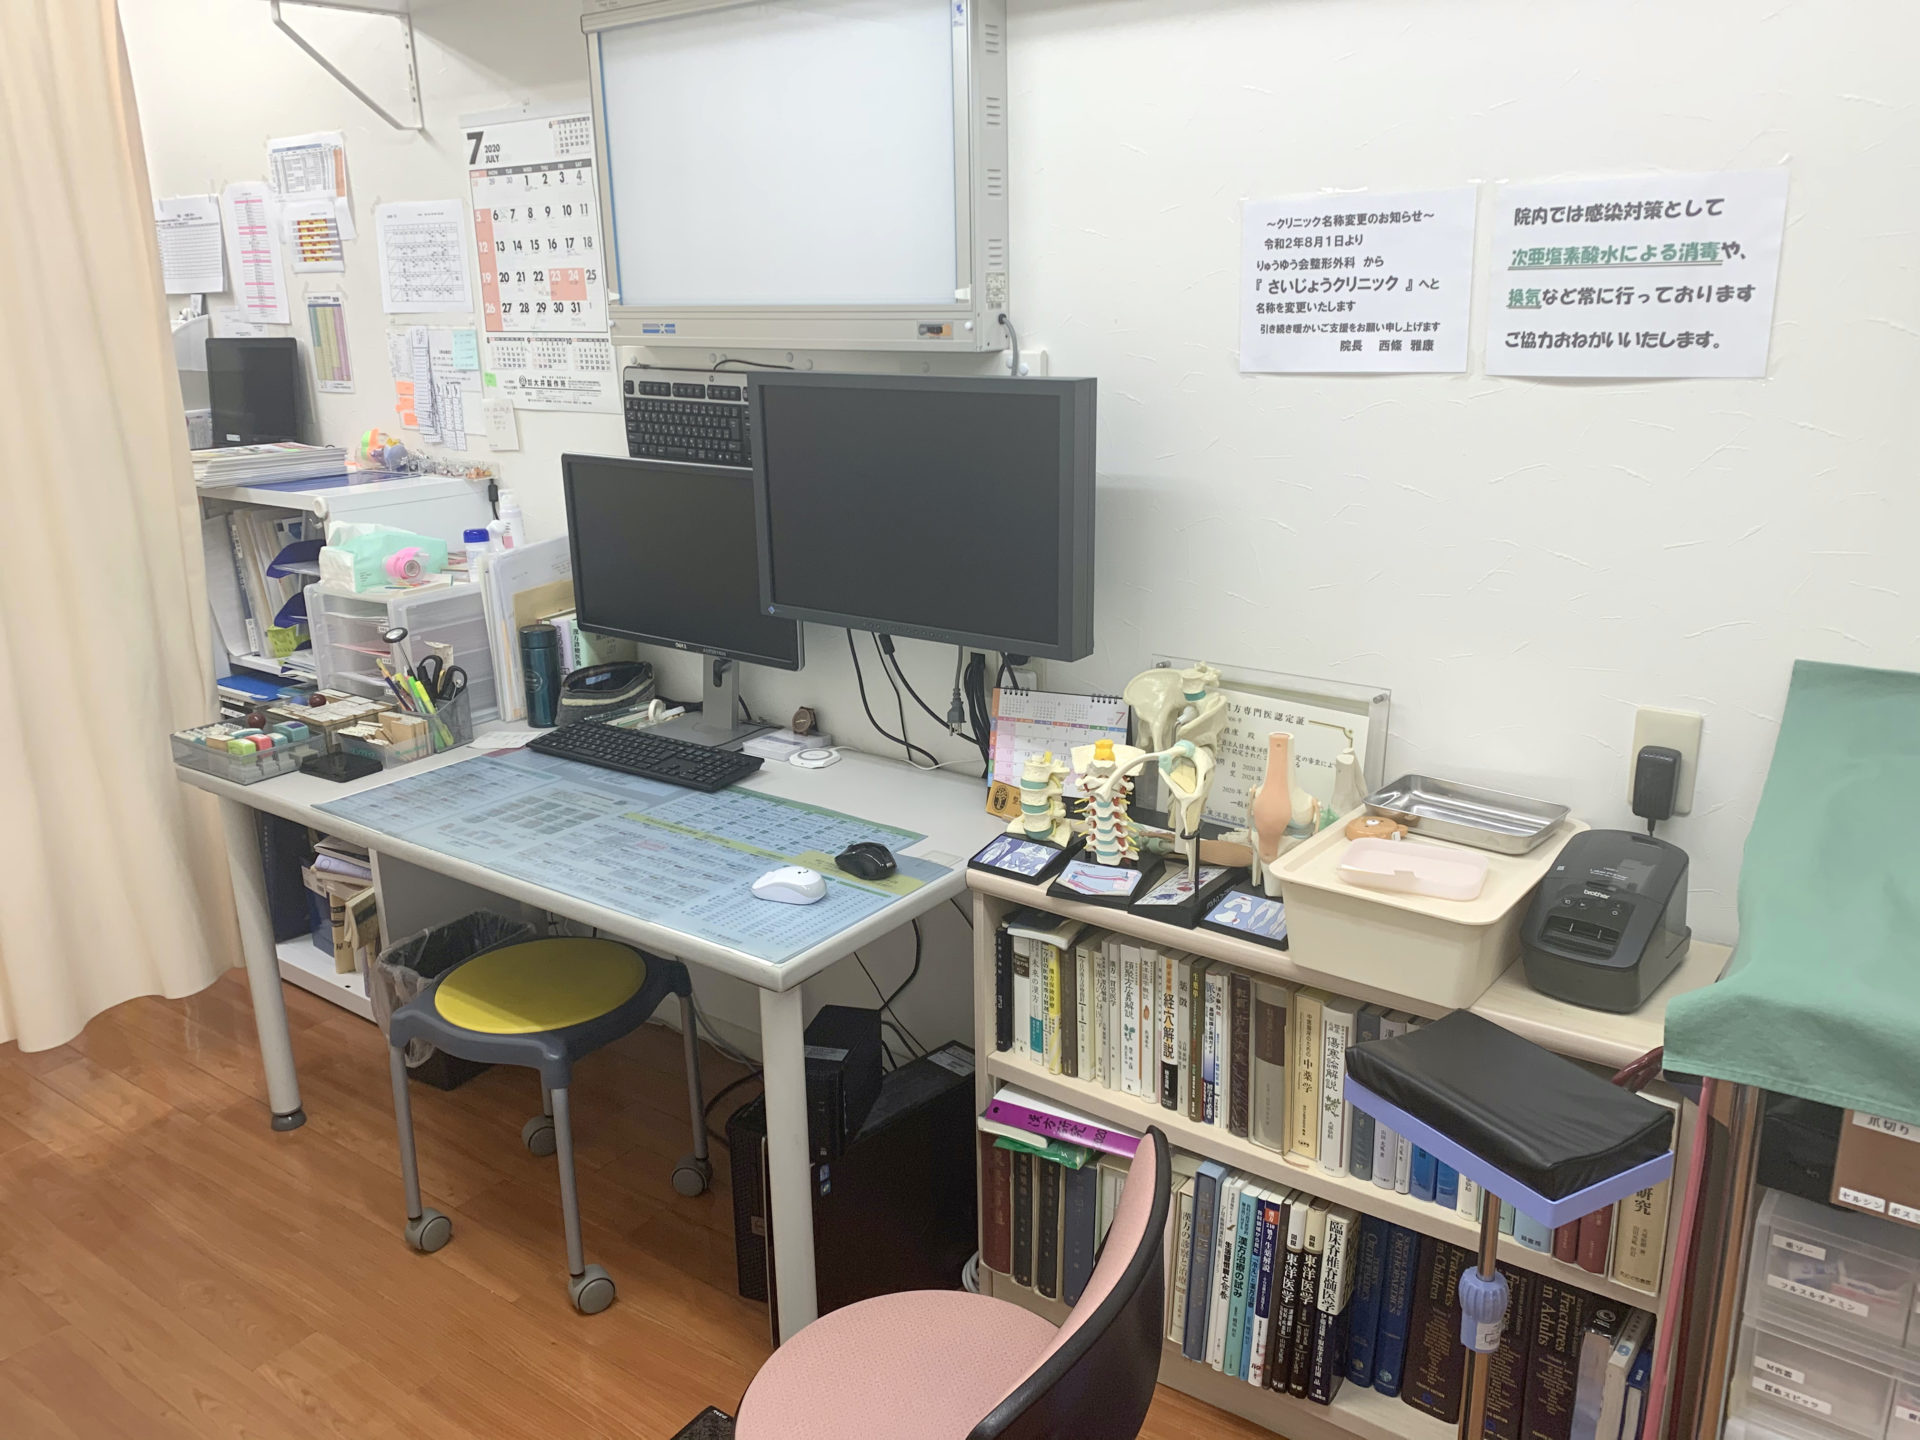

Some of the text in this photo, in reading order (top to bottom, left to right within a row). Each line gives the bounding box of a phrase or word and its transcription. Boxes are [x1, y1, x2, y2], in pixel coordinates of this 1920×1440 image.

[467, 131, 484, 165] 7
[484, 144, 500, 153] 2020
[485, 155, 500, 163] JULY
[525, 175, 529, 185] 1
[542, 174, 548, 184] 2
[560, 172, 565, 183] 3
[576, 170, 582, 181] 4
[476, 204, 588, 222] 5 6 7 8 9 10 11
[1513, 198, 1725, 226] 院内では感染対策として
[479, 237, 592, 252] 12 13 14 15 16 17 18
[1511, 241, 1747, 266] 次亜塩素酸水による消毒や、
[1256, 256, 1384, 271] りゅうゆう会整形外科 から
[482, 270, 596, 283] 19 20 21 22 23 24 25
[1508, 285, 1755, 306] 換気など常に行っております
[486, 303, 495, 314] 26
[502, 303, 512, 313] 27
[519, 303, 529, 313] 28
[536, 302, 546, 313] 29
[554, 302, 564, 312] 30
[571, 302, 581, 312] 31
[1256, 301, 1356, 314] 名称を変更いたします
[1260, 322, 1440, 335] 引き続き暖かいご支援をお願い申し上げます
[1340, 340, 1363, 352] 院長
[1505, 331, 1720, 350] ご協力おねがいいたします。
[1116, 712, 1125, 725] 7
[1583, 889, 1610, 900] brother
[1163, 993, 1175, 1059] 経穴解説
[1868, 1116, 1909, 1135] 爪切り
[1842, 1191, 1882, 1209] セルシン
[1436, 1242, 1448, 1253] in
[1281, 1233, 1298, 1303] 図説 東洋医学
[1300, 1234, 1318, 1305] 図説 東洋医学
[1430, 1254, 1447, 1300] Children
[1444, 1248, 1465, 1307] Fractures
[1781, 1282, 1856, 1311] フルスルチアミン
[1538, 1284, 1557, 1346] in Adults
[1555, 1291, 1576, 1352] Fractures
